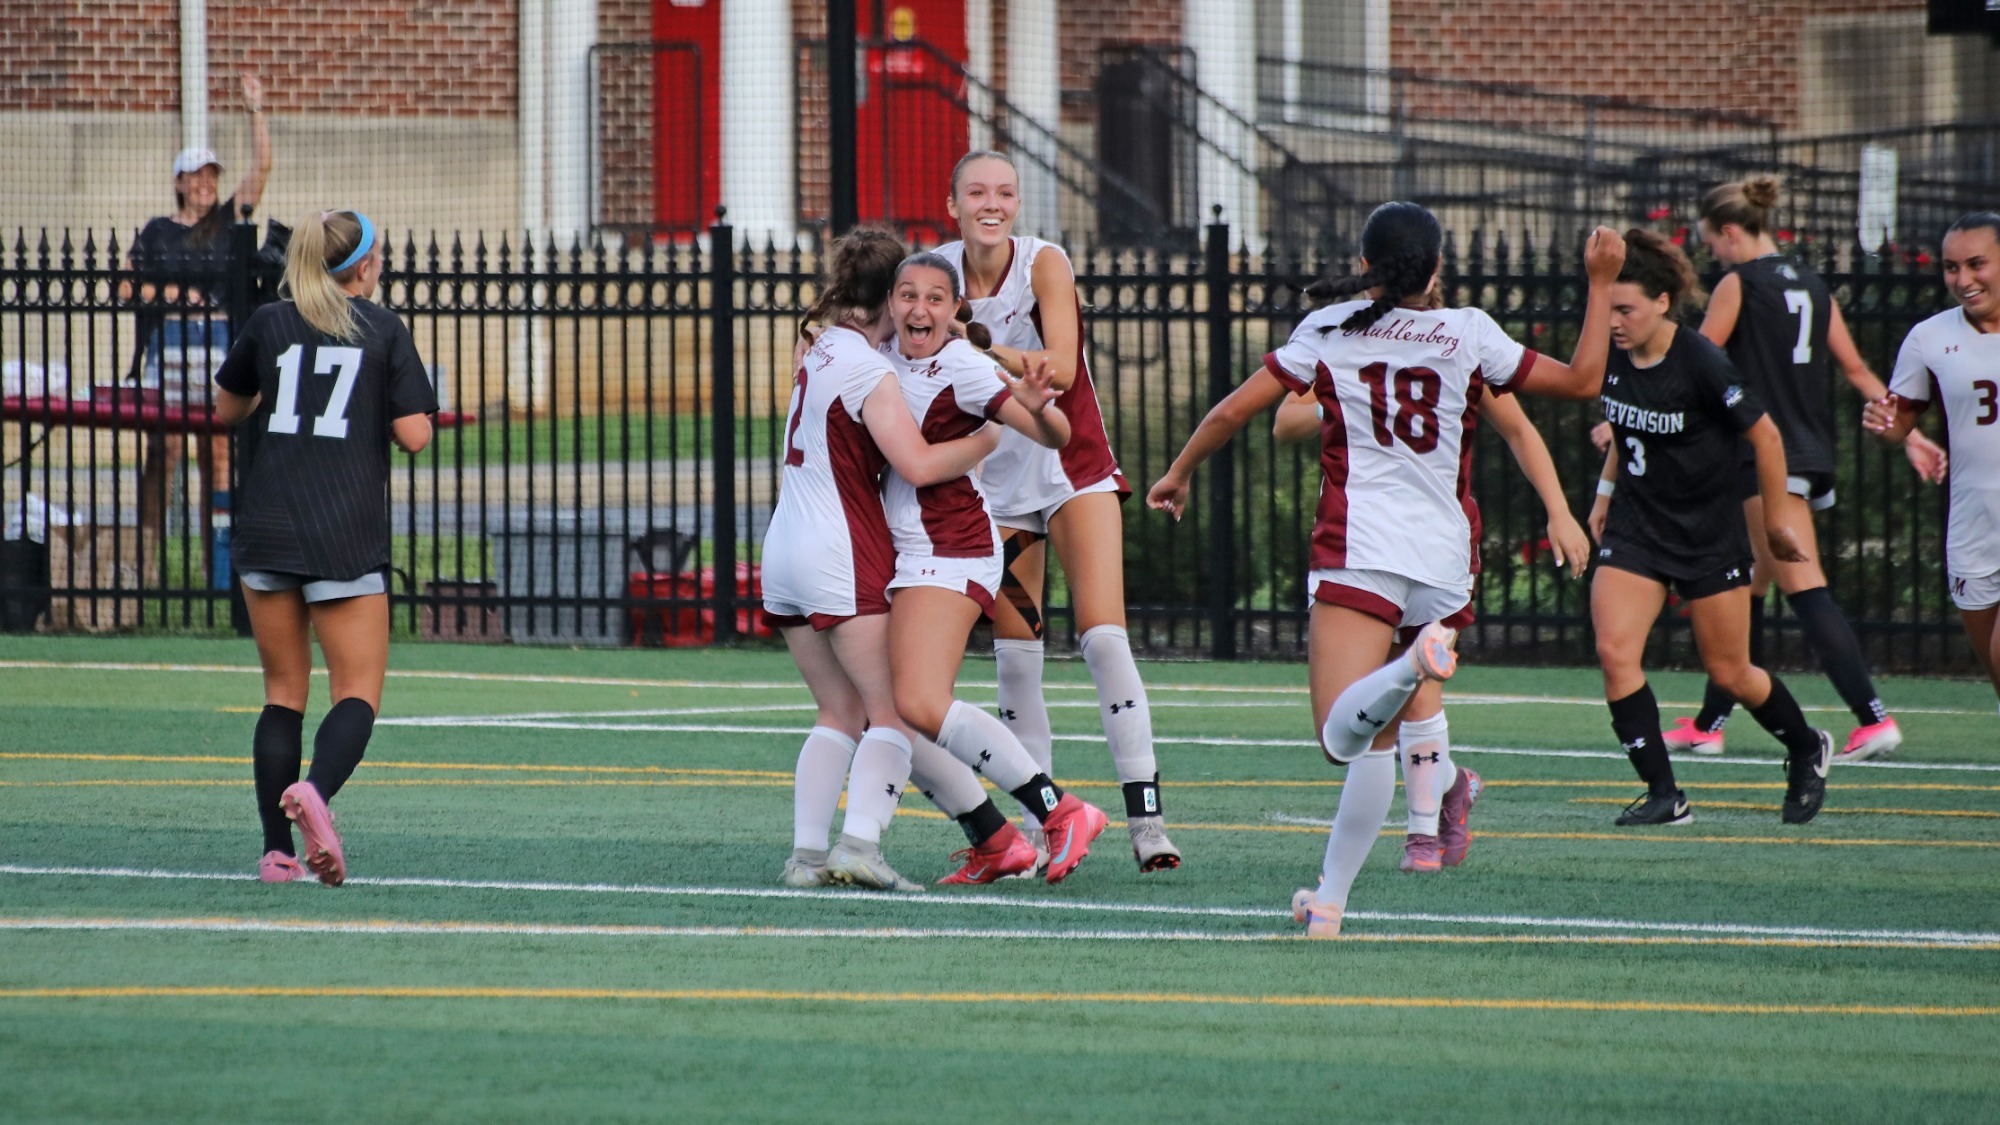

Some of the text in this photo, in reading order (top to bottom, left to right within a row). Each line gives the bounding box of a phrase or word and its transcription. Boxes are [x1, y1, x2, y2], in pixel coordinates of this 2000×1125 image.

[1783, 289, 1813, 364] 7
[267, 343, 364, 438] 17
[785, 365, 808, 467] 2
[1358, 361, 1441, 455] 18
[1600, 395, 1684, 434] TEVENSON
[1972, 379, 1998, 426] 3
[1625, 436, 1646, 476] 3
